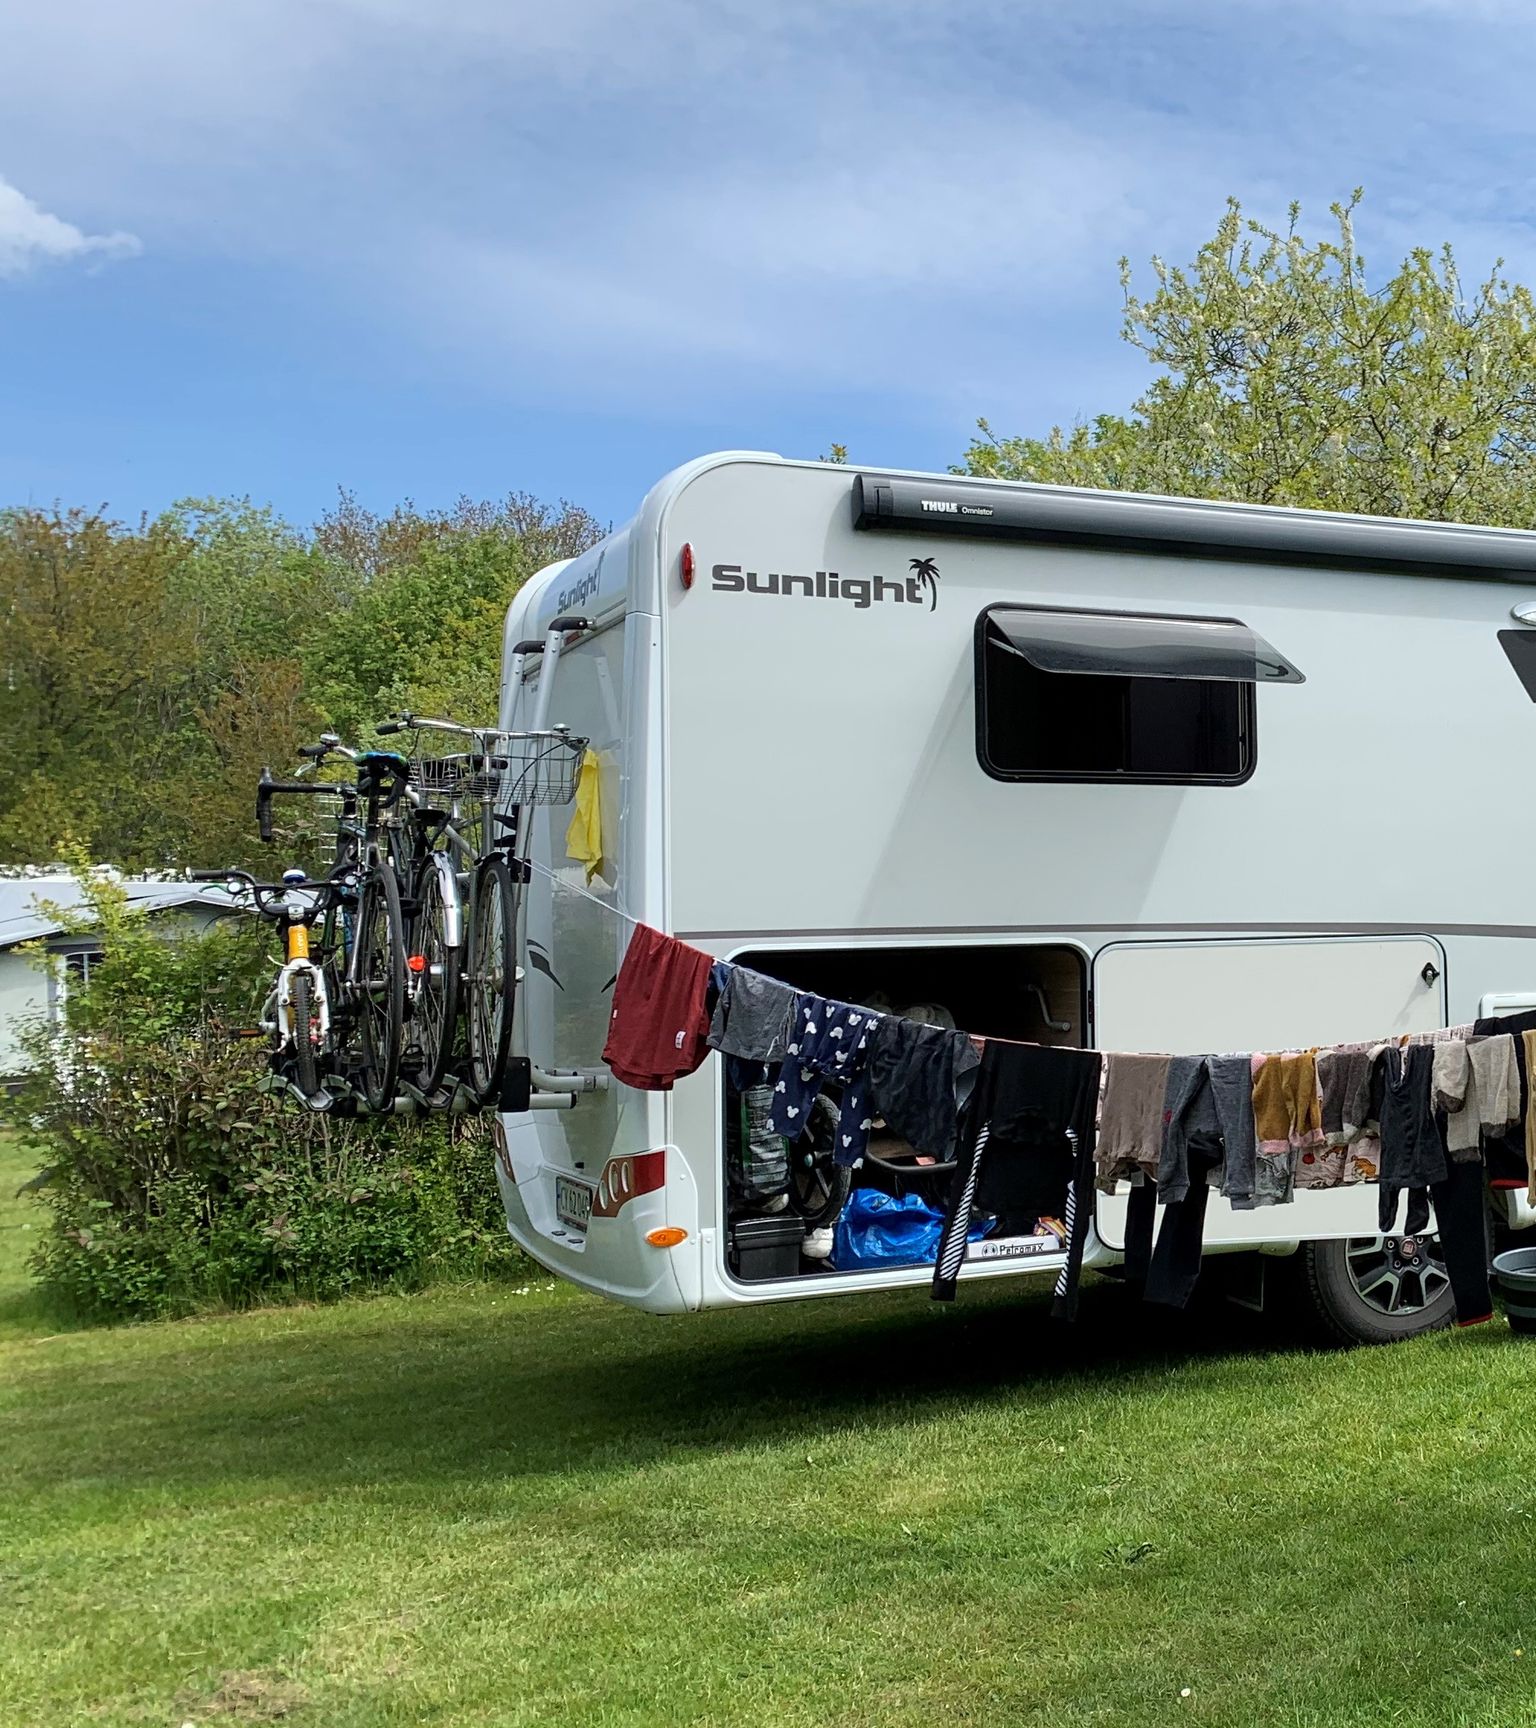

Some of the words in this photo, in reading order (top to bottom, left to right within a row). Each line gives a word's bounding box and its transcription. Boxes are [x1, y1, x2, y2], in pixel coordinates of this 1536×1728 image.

[921, 500, 958, 513] THULE
[961, 506, 994, 516] Omnistor
[556, 568, 597, 615] Sunlight
[711, 563, 923, 609] Sunlight
[999, 1242, 1044, 1256] Petromax
